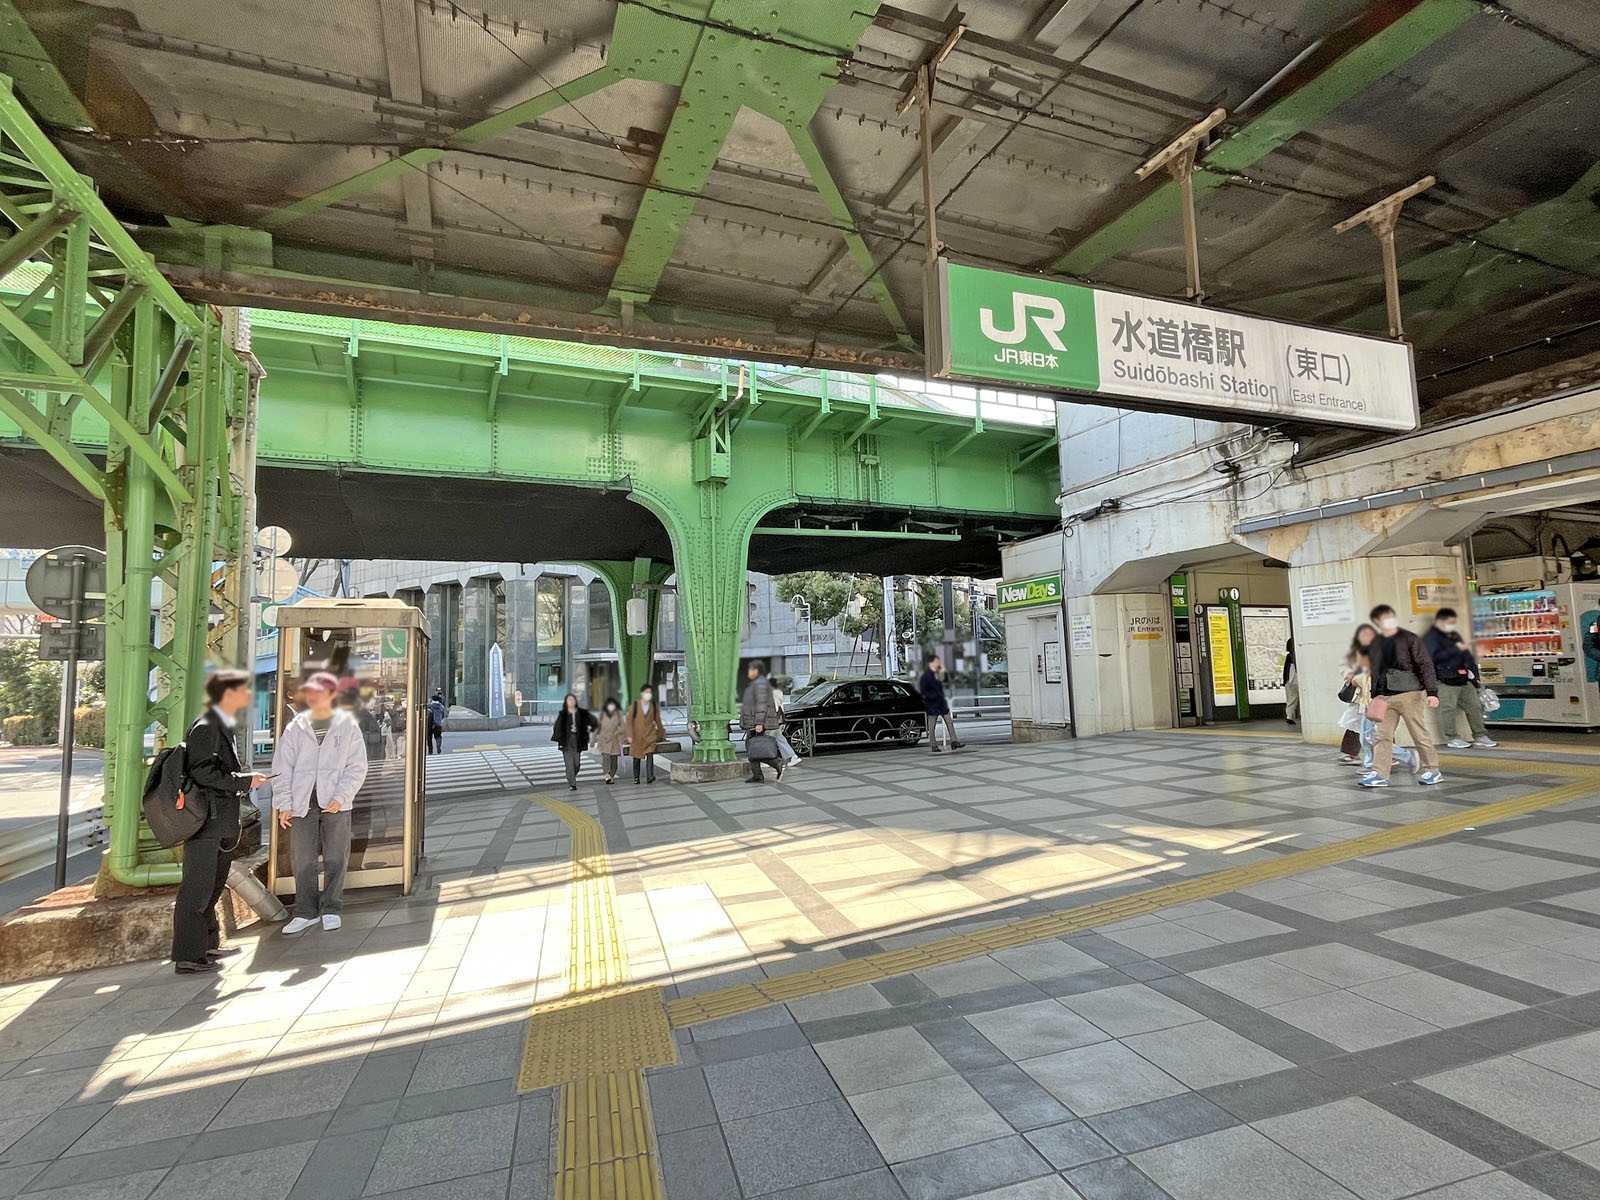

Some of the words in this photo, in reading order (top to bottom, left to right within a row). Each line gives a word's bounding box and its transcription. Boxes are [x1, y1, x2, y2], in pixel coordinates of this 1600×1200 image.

[979, 291, 1068, 352] JR
[1111, 310, 1248, 369] 水道橋駅
[994, 347, 1060, 370] JR東日本
[1113, 359, 1215, 391] Suidōbashi
[1220, 373, 1279, 400] Station
[1289, 389, 1318, 405] (East
[1319, 393, 1368, 412] Entrance)
[1130, 616, 1161, 626] JRのりば
[1137, 625, 1164, 633] Entrance
